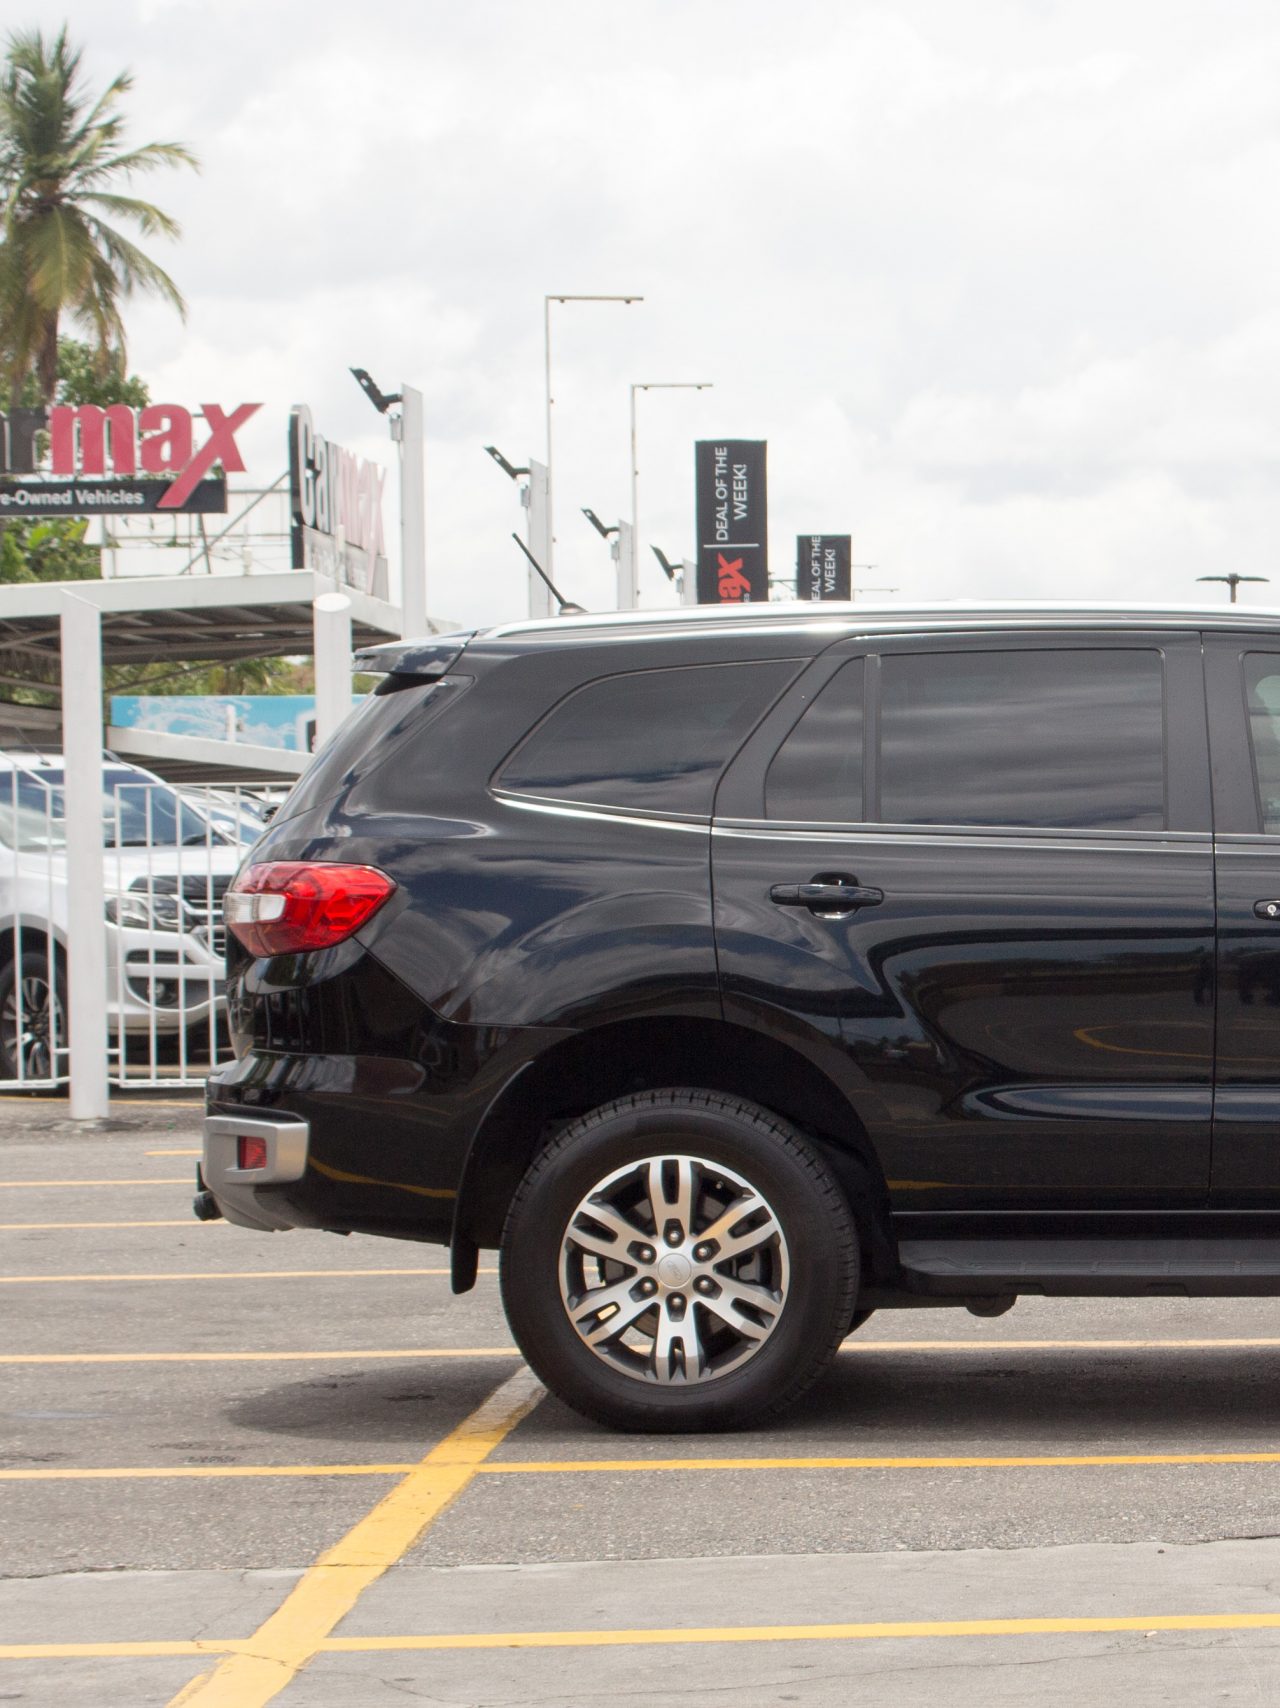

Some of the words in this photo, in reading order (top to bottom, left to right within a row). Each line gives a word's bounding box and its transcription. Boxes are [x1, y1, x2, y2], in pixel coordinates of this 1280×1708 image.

[0, 403, 264, 508] rmax
[714, 446, 728, 478] THE
[74, 489, 145, 506] Vehicles
[715, 479, 728, 500] OF
[732, 463, 748, 521] WEEK!
[715, 502, 729, 541] DEAL
[811, 535, 821, 558] THE
[718, 552, 751, 604] ax
[811, 559, 821, 577] OF
[824, 548, 836, 593] WEEK!
